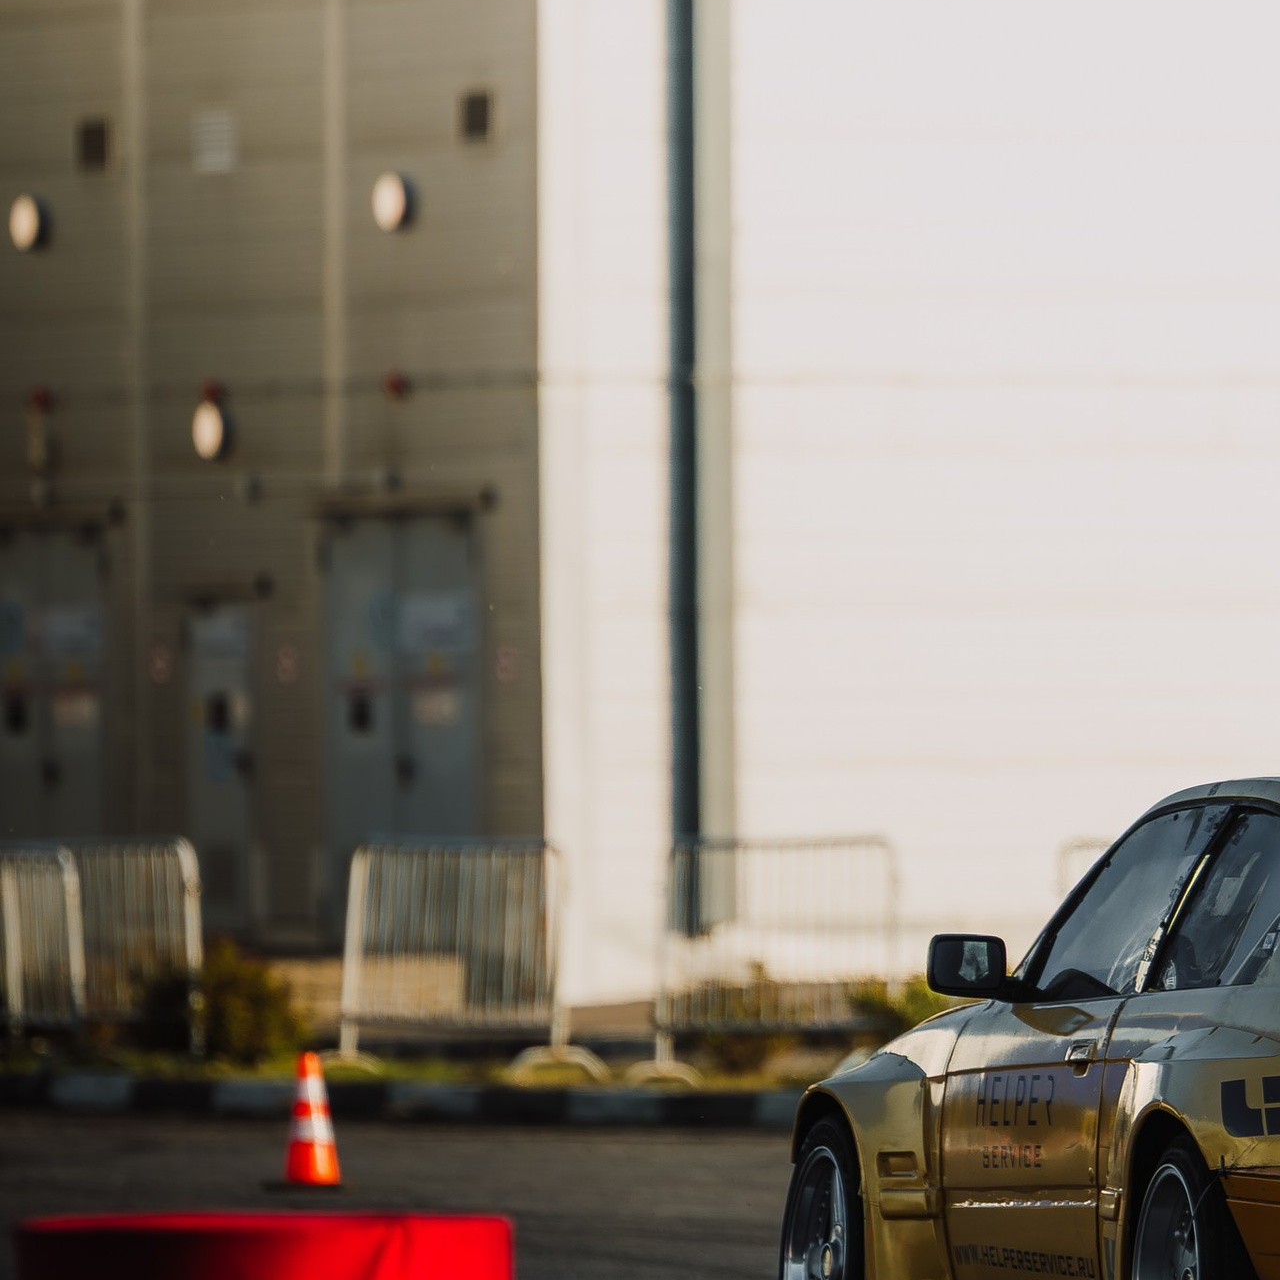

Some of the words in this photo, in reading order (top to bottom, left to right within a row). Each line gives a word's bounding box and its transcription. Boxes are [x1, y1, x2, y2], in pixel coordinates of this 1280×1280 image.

[975, 1074, 1055, 1127] HELPER
[982, 1144, 1042, 1169] SERVICE
[952, 1243, 1096, 1279] WWW.HELPERSERVICE.RU
